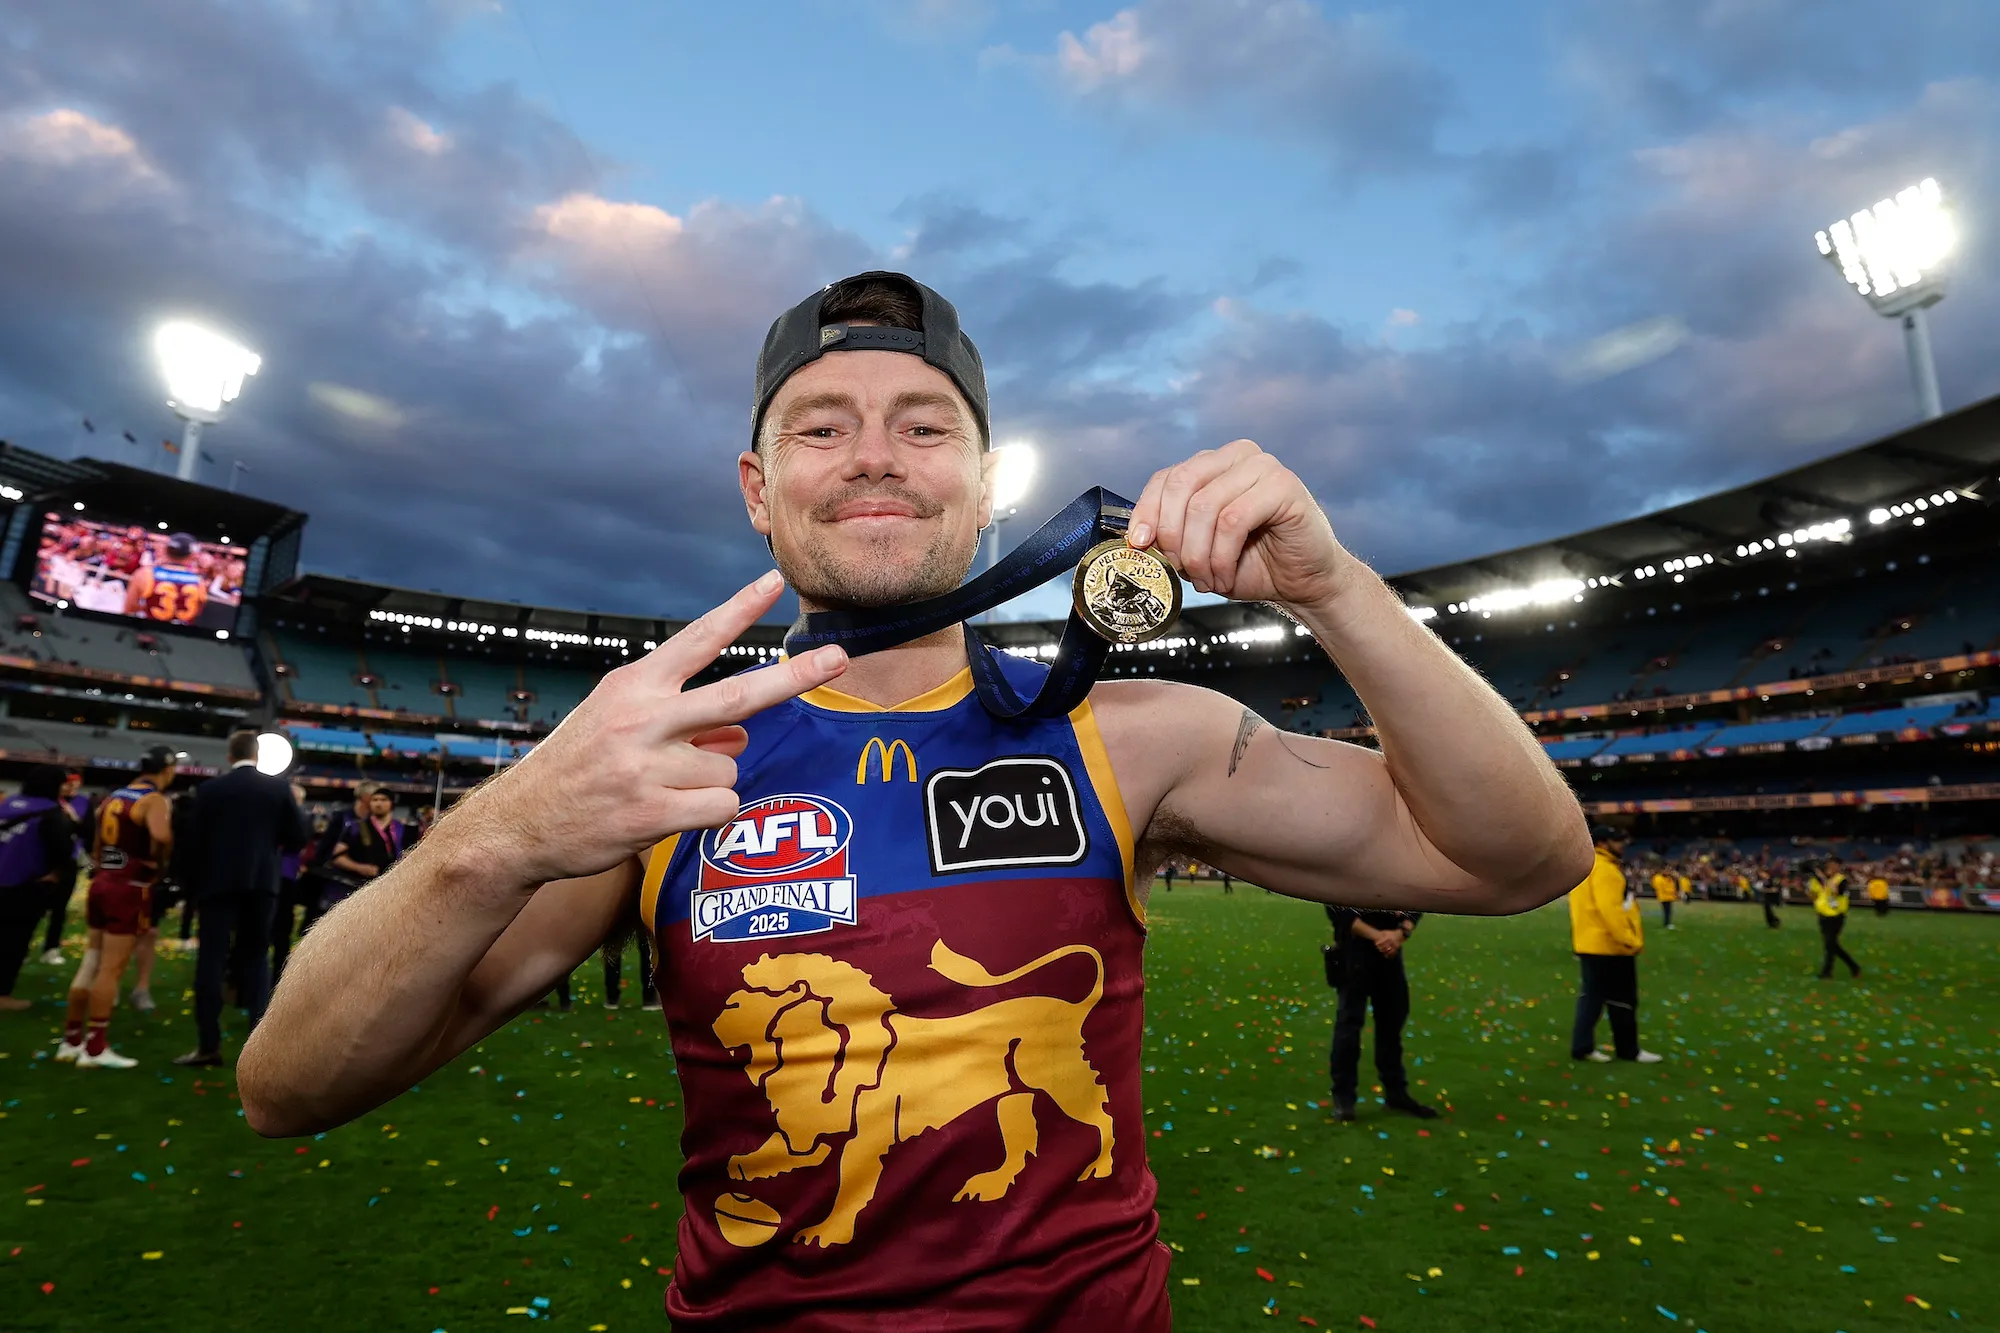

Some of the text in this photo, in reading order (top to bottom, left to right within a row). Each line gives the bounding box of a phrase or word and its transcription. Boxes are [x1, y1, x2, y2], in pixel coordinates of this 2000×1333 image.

[1128, 566, 1162, 579] 2025
[150, 581, 200, 622] 33
[101, 797, 125, 846] 6
[712, 809, 838, 860] AFL
[948, 776, 1060, 850] youi
[698, 881, 849, 927] GRAND FINAL
[748, 912, 790, 935] 2025
